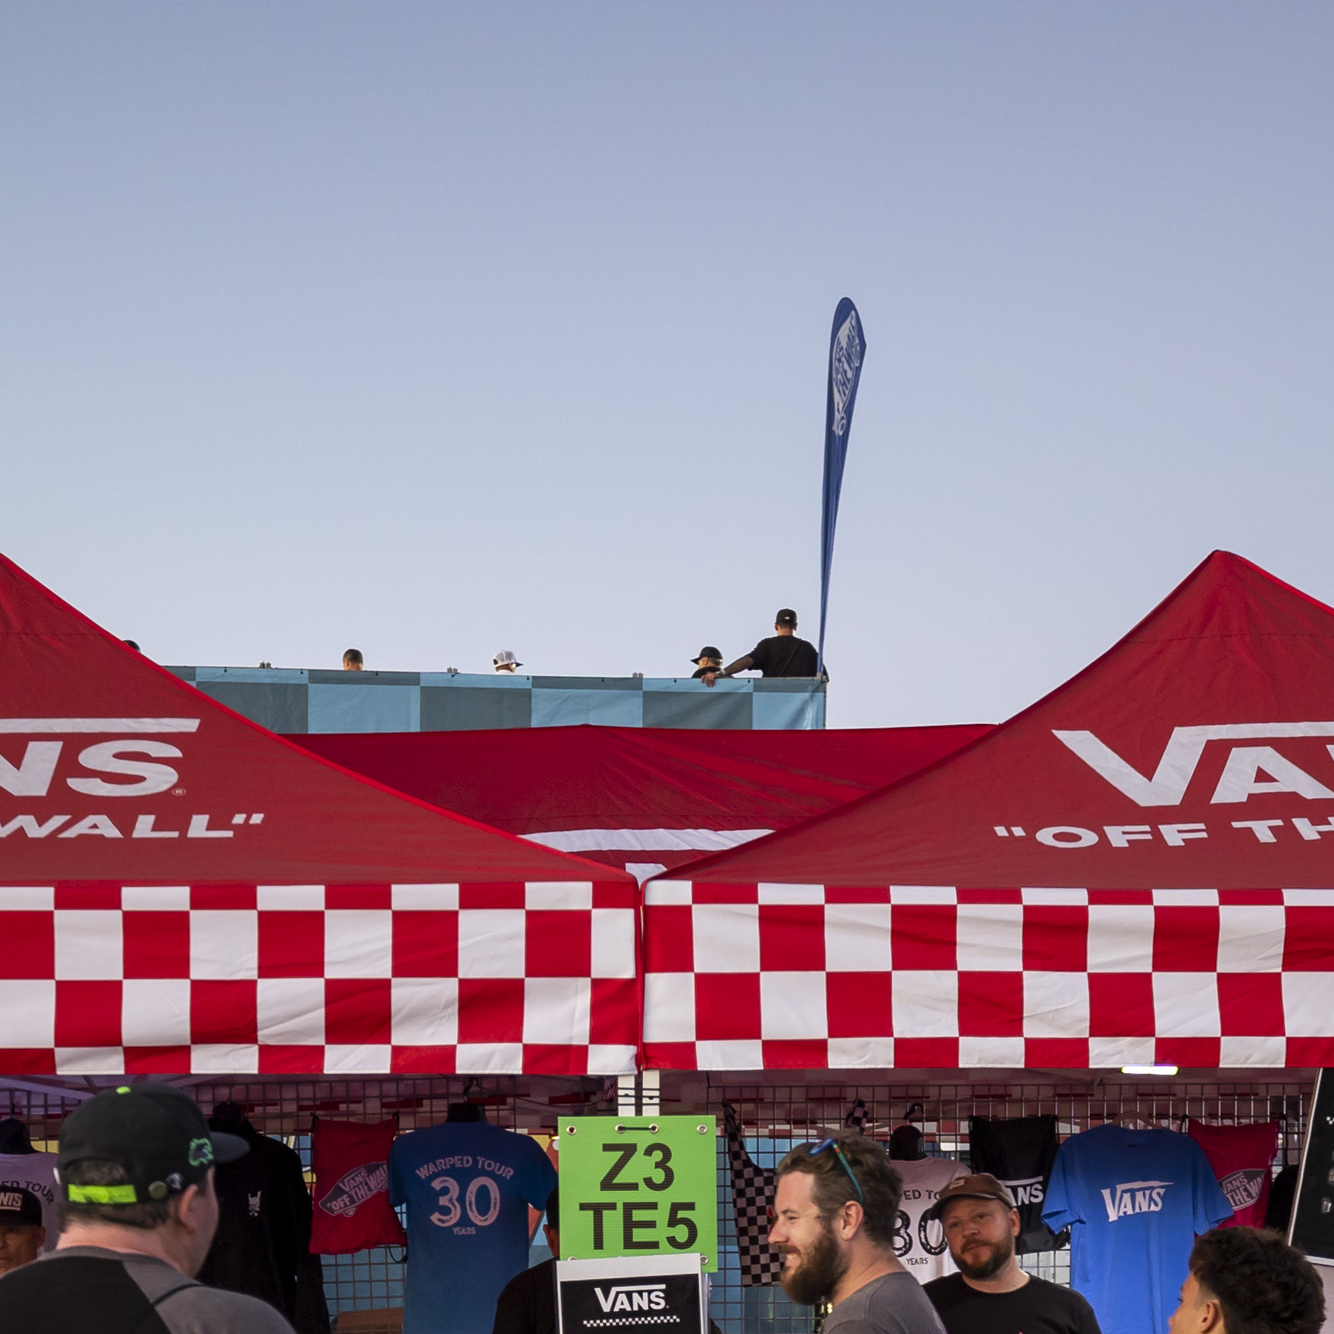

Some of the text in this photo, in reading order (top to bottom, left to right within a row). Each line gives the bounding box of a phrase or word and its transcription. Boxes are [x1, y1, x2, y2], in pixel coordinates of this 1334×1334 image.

[994, 822, 1222, 850] "OFF
[415, 1156, 515, 1180] WARPED TOUR
[600, 1143, 674, 1191] Z3
[430, 1176, 500, 1227] 30
[1100, 1180, 1174, 1222] VANS
[579, 1202, 698, 1250] TE5
[594, 1284, 667, 1312] VANS
